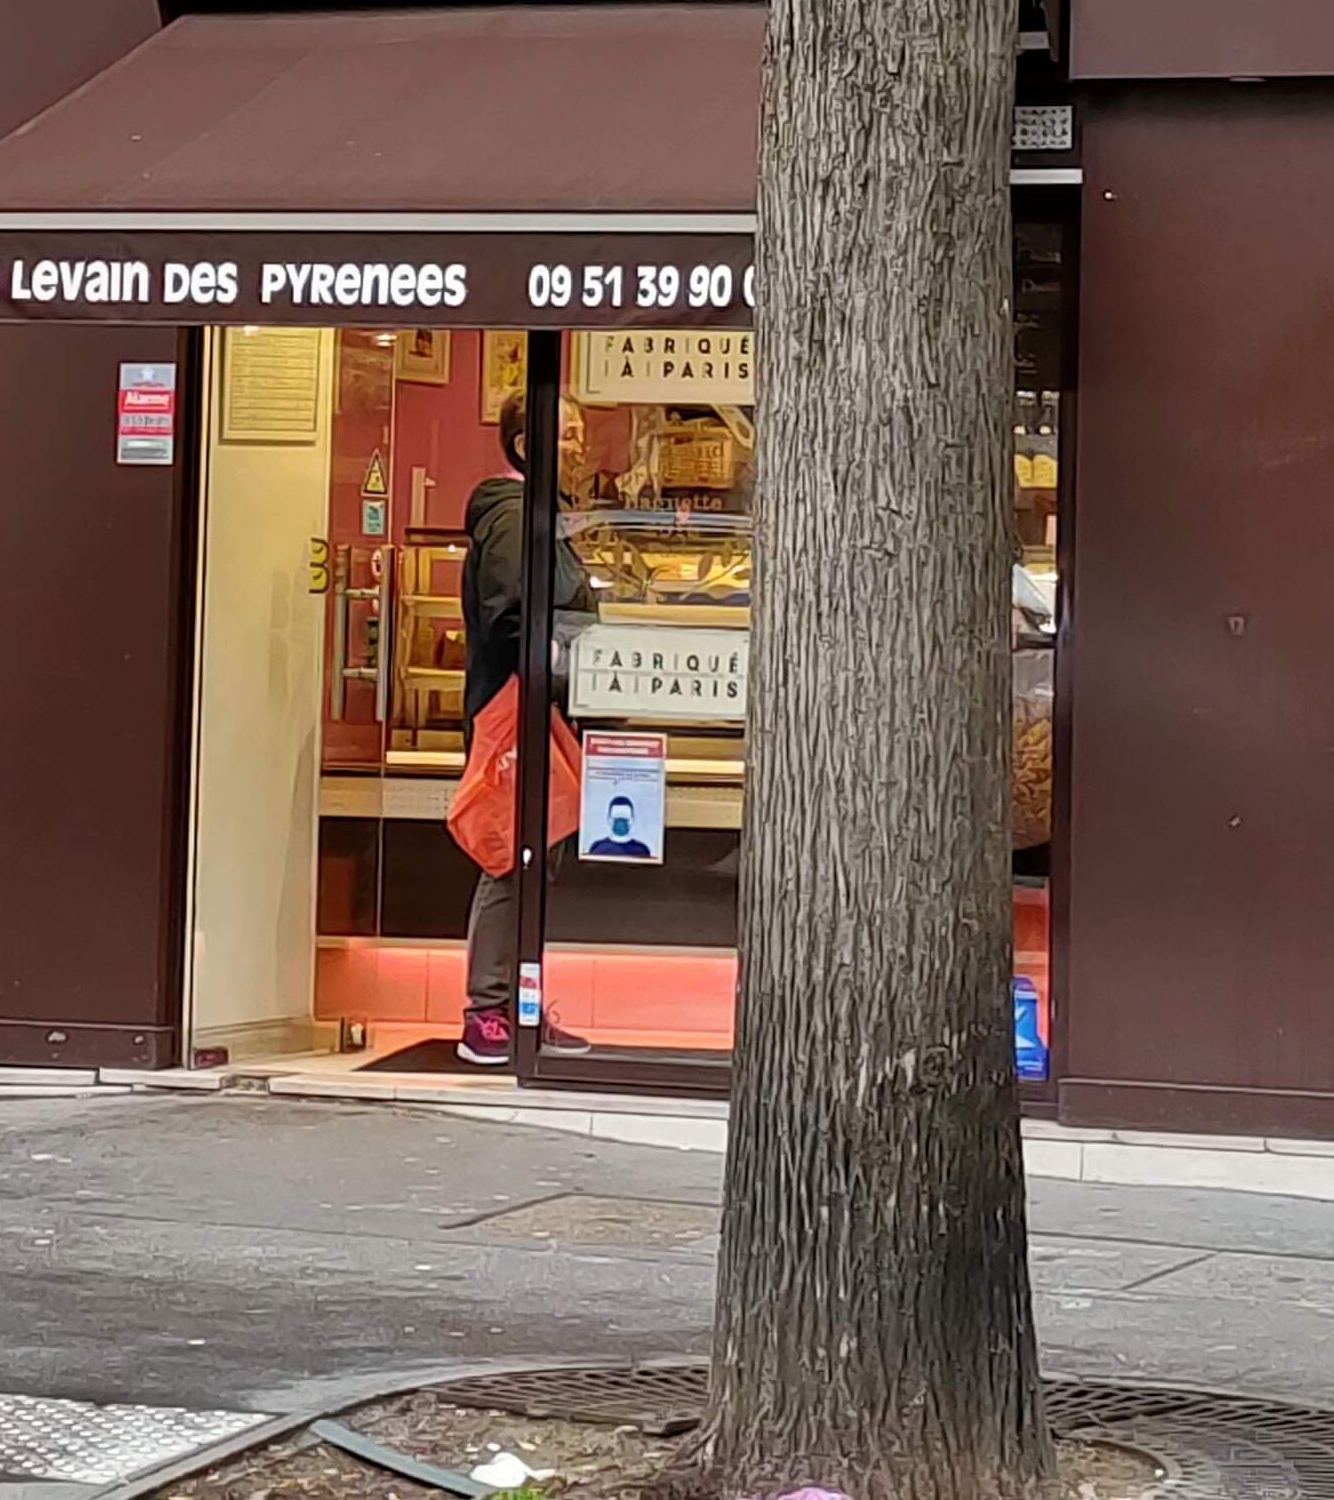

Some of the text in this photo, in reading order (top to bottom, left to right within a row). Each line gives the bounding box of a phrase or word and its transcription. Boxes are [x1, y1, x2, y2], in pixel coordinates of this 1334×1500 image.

[528, 263, 572, 308] 09
[581, 264, 623, 308] 51
[636, 264, 679, 308] 39
[688, 265, 732, 308] 90
[604, 335, 749, 355] FABRIQUÉ
[663, 361, 749, 380] PARIS
[593, 650, 738, 673] FABRIQUÉ
[652, 677, 738, 699] PARIS
